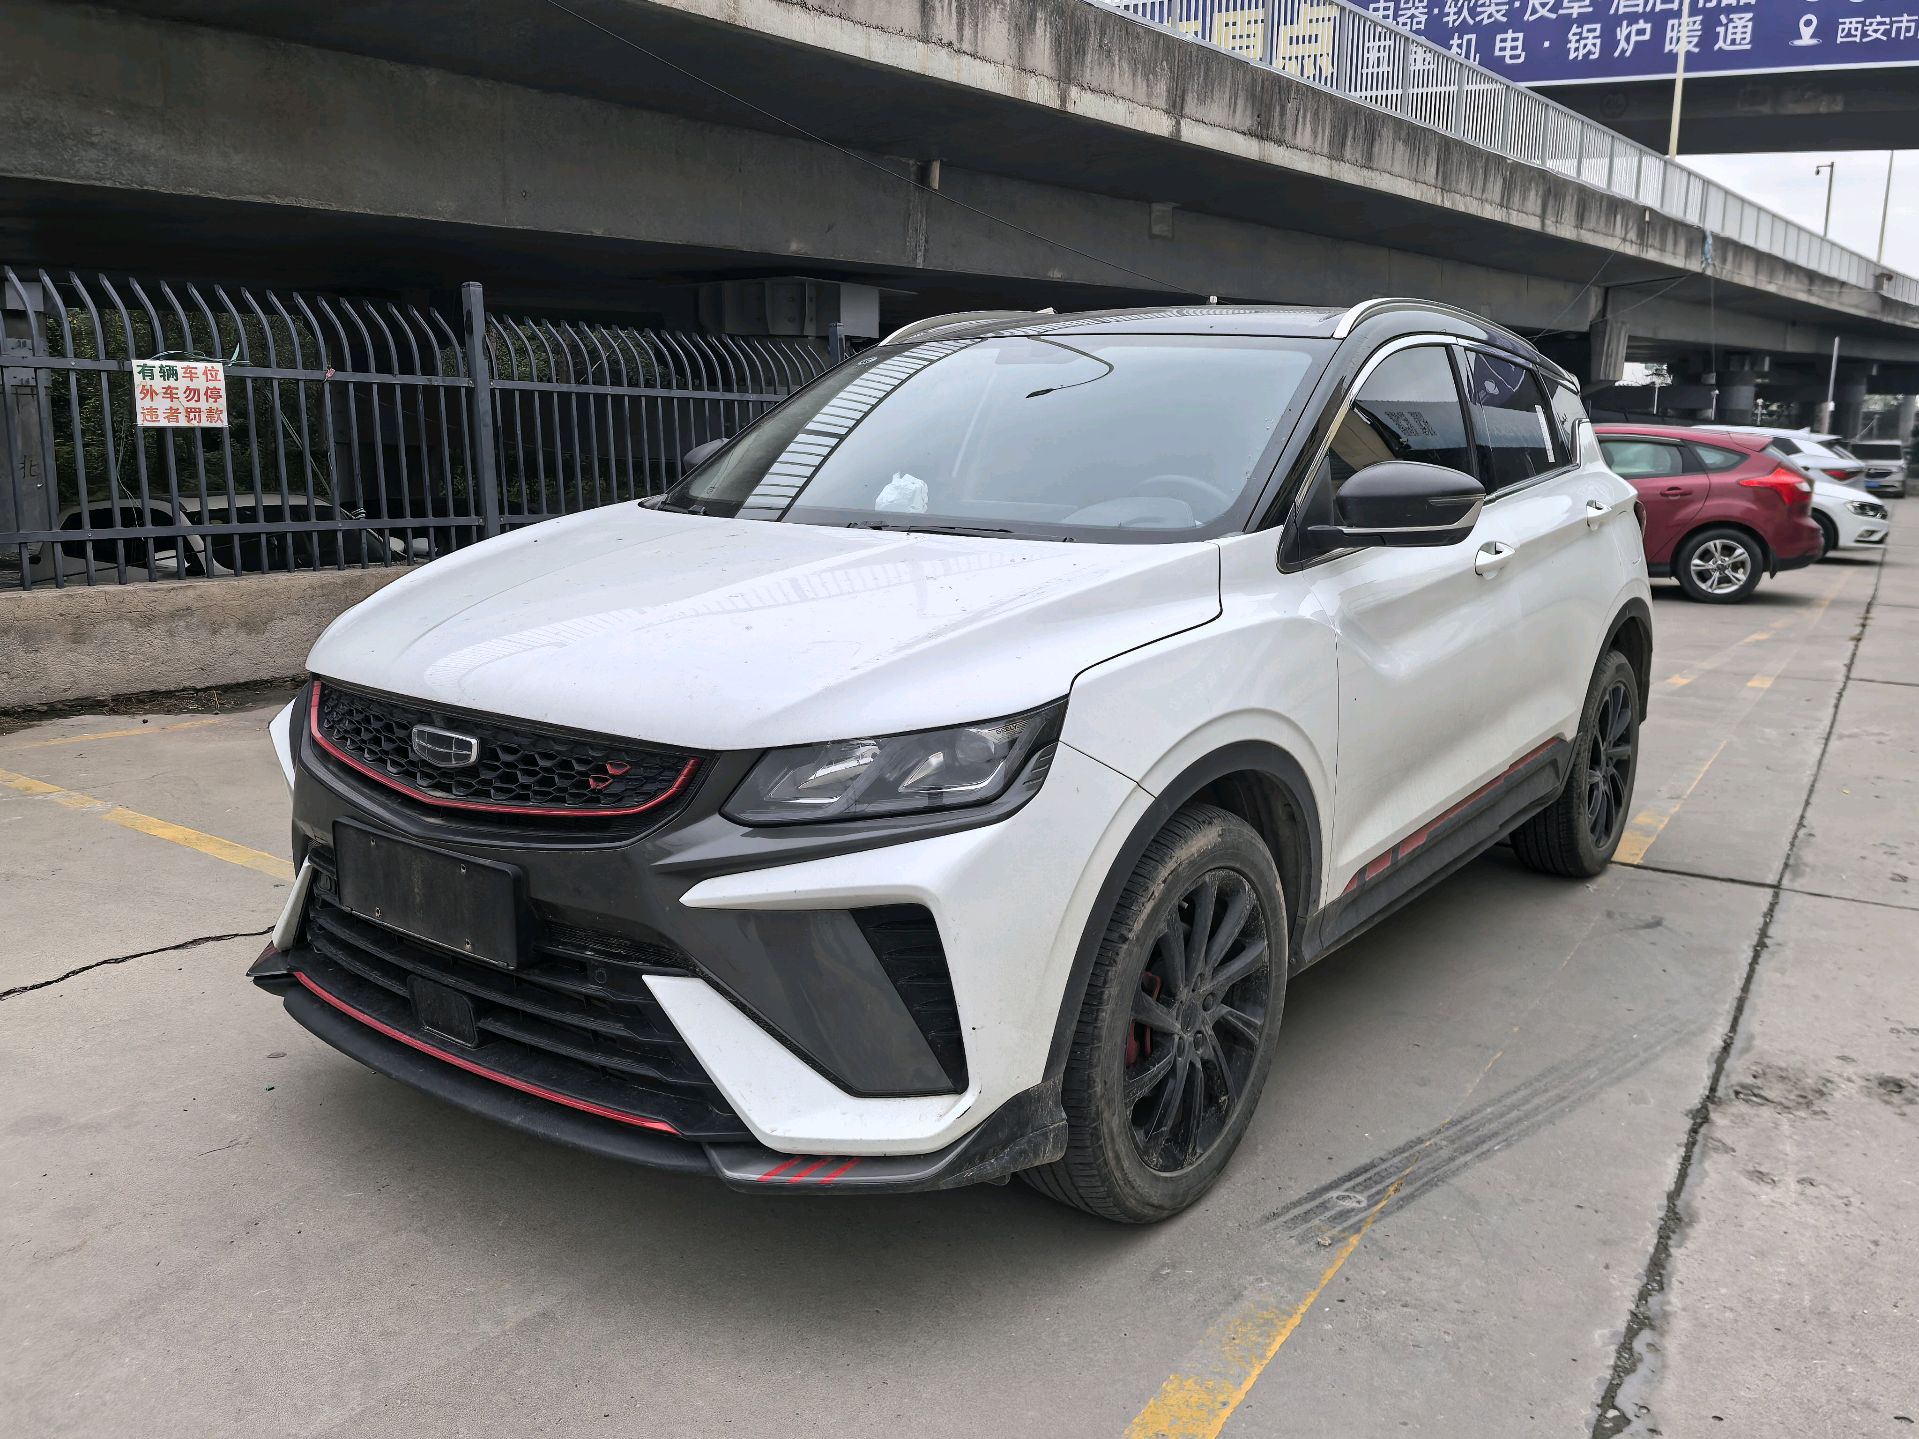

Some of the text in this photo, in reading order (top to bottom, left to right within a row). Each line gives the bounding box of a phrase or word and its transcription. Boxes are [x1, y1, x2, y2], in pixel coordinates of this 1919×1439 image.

[1836, 13, 1919, 44] 西安市
[136, 363, 223, 383] 有辆车位
[139, 384, 223, 403] 外车勿停
[140, 406, 224, 424] 违者罚款
